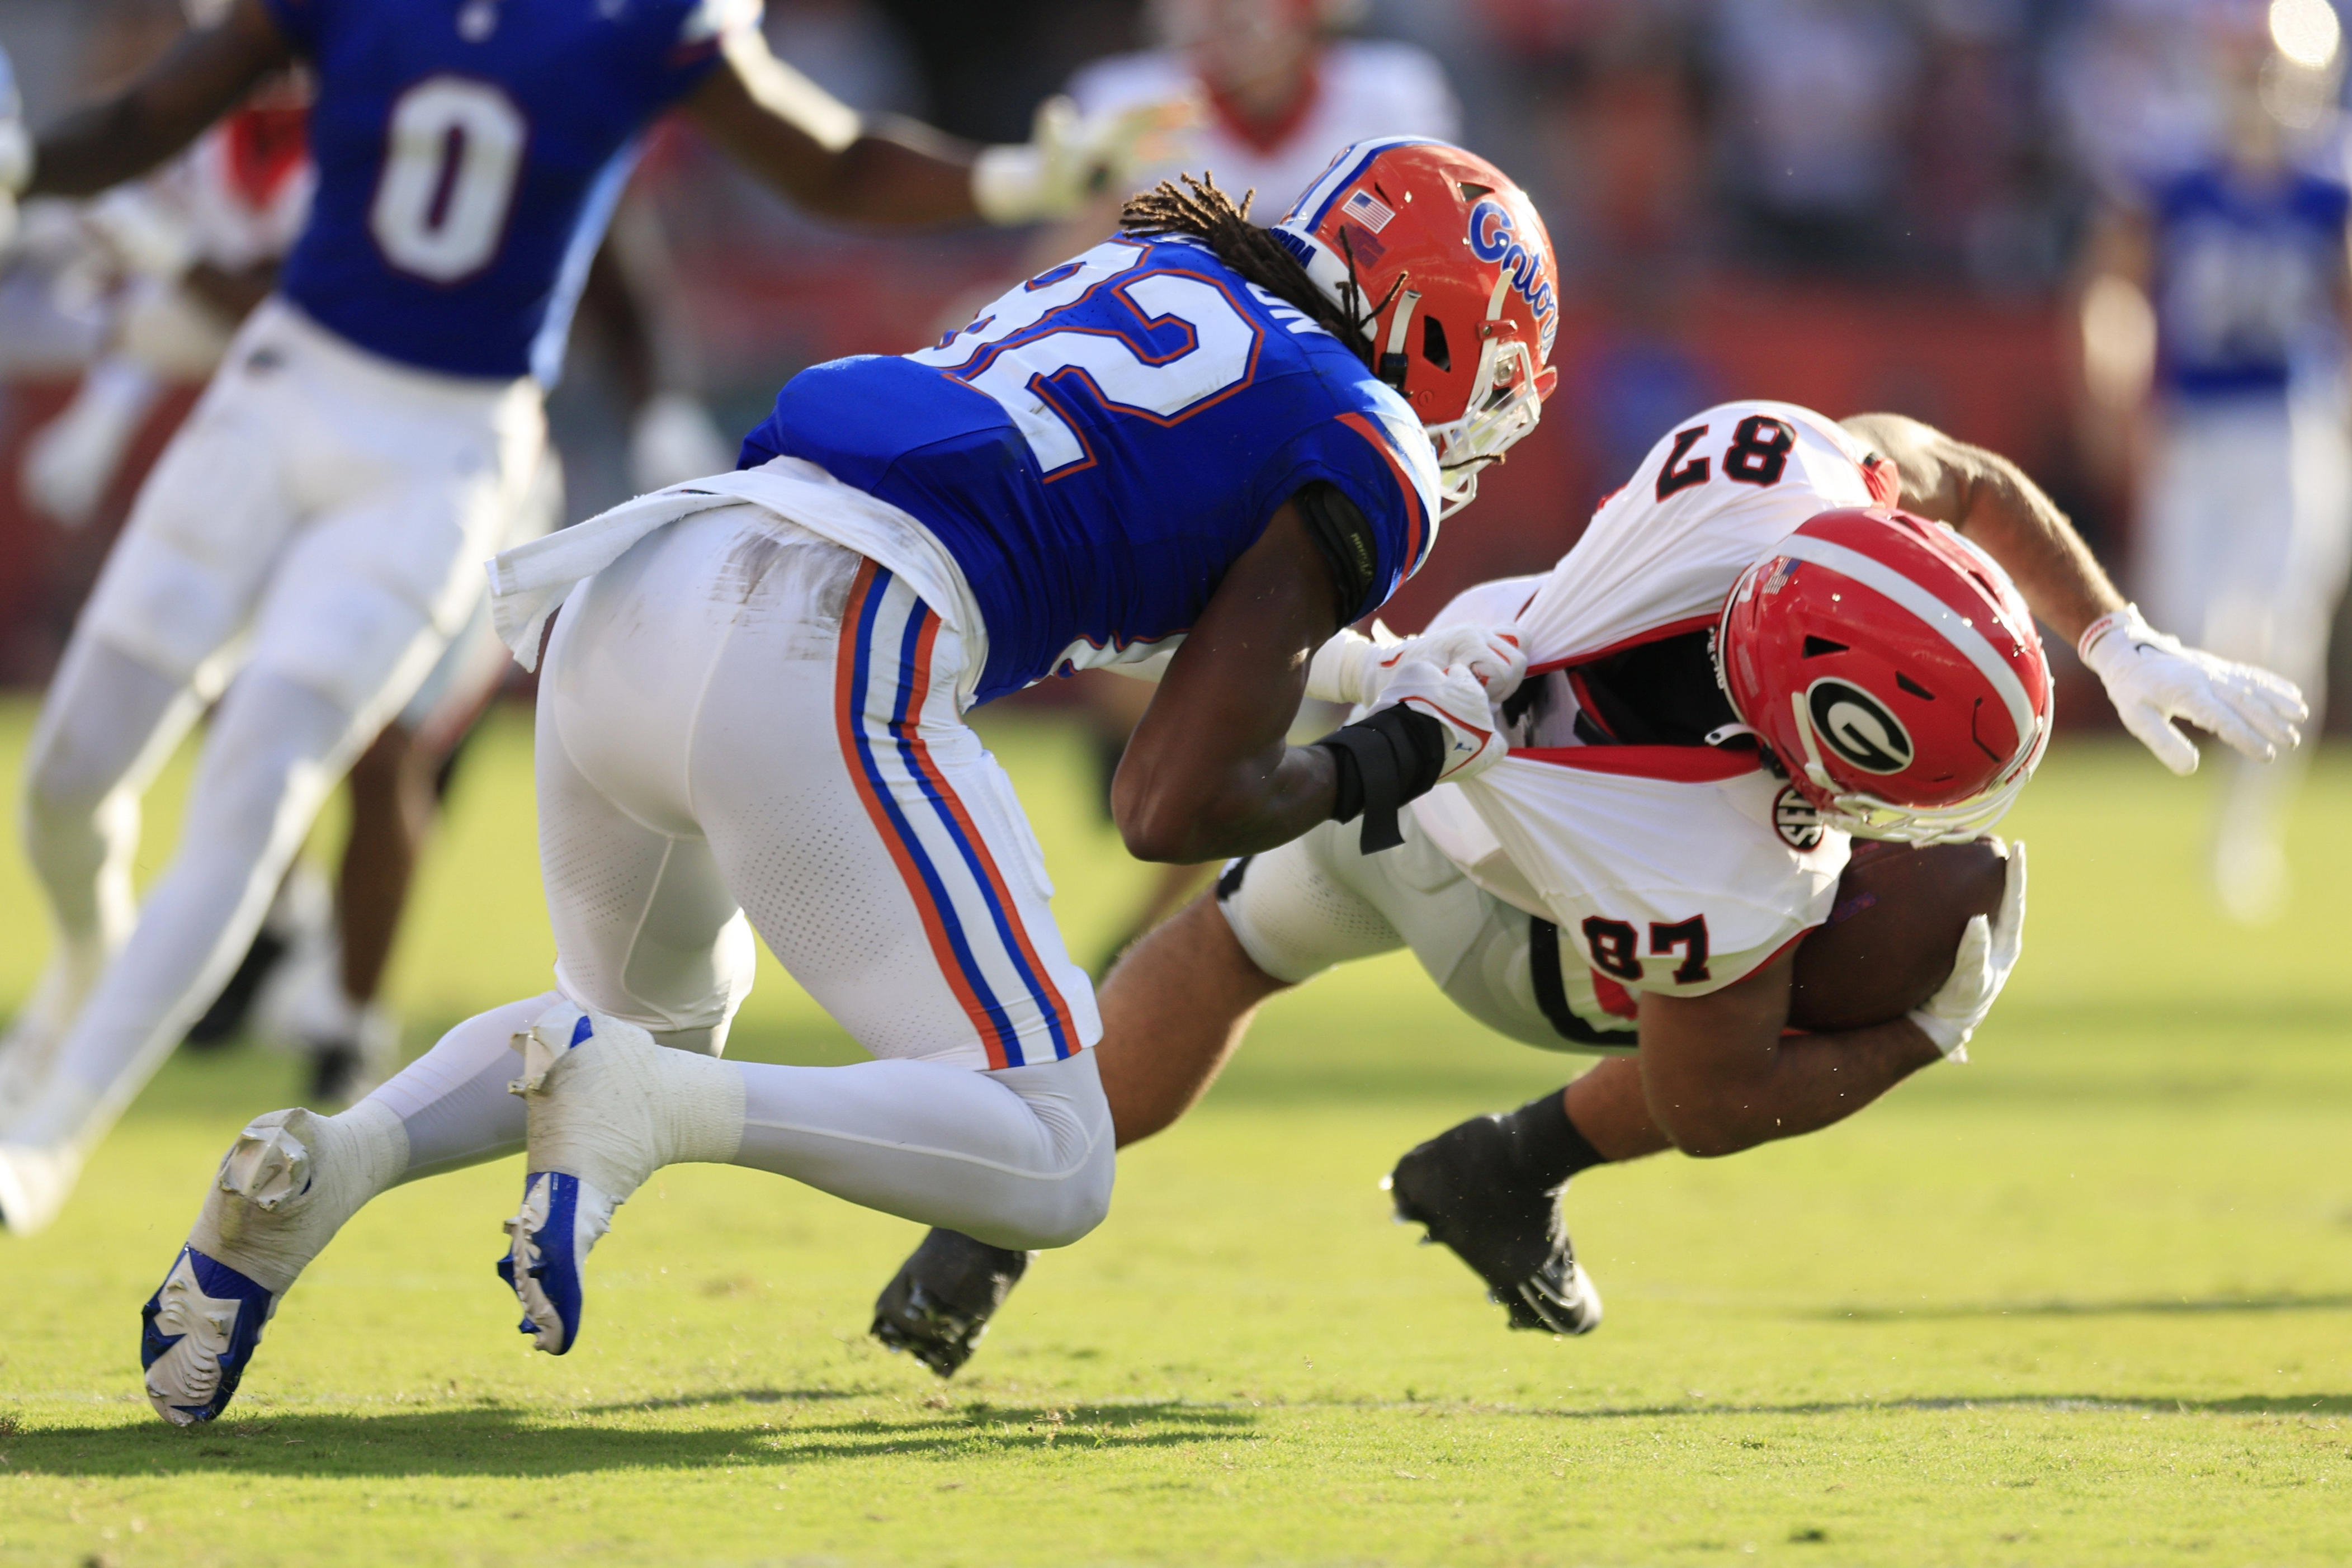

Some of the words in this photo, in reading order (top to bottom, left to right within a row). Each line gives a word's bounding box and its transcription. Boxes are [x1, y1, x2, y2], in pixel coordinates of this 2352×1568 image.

[367, 72, 529, 286] 0
[1655, 414, 1798, 503] 87
[1808, 681, 1911, 772] G
[1581, 913, 1711, 986] 87
